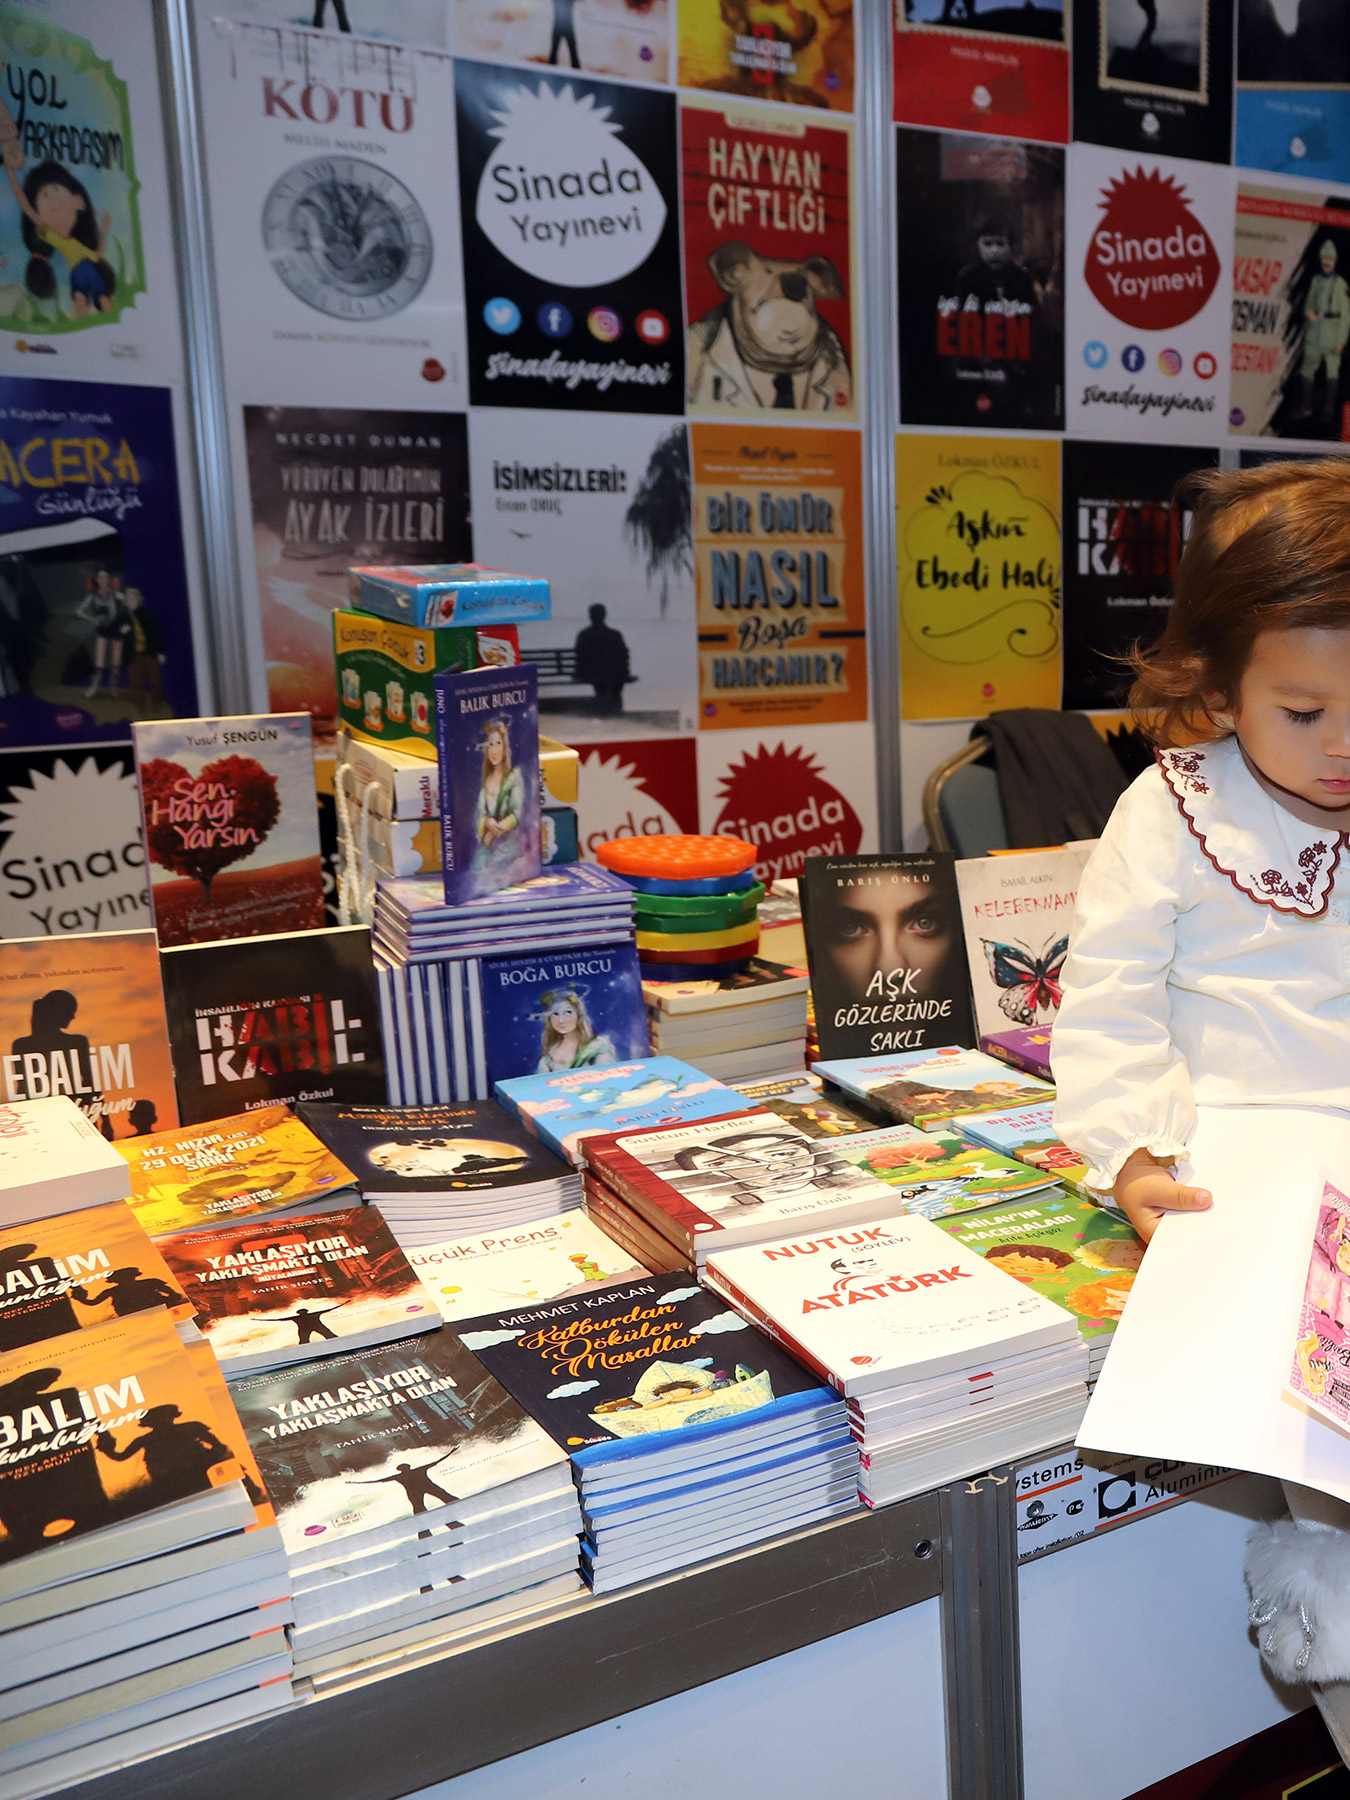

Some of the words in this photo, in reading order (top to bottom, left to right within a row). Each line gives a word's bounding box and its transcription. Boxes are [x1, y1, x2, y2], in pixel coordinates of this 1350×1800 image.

[6, 63, 67, 138] YOL
[261, 76, 416, 133] KÖTÜ
[709, 137, 821, 189] HAYVAN
[493, 158, 642, 205] Sinada
[509, 206, 643, 246] Yayınevi
[1096, 226, 1207, 268] Sinada
[1105, 266, 1203, 300] Yayınevi
[937, 310, 1032, 361] EREN
[275, 432, 356, 446] NECDET
[369, 434, 441, 448] DUMAN
[284, 498, 351, 543] AYAK
[757, 490, 834, 533] ÖMÜR
[711, 548, 840, 611] NASIL
[914, 557, 991, 593] Ebedi
[459, 693, 490, 715] BALIK
[492, 688, 528, 708] BURCU
[186, 734, 219, 746] Yusuf
[222, 730, 279, 747] ŞENGÜN
[152, 796, 236, 827] Hangi
[717, 796, 846, 850] Sinada
[173, 823, 260, 850] Yarsın
[3, 829, 147, 902] Sinad
[836, 878, 882, 888] BARIŞ
[891, 874, 931, 886] ÜNLÜ
[974, 892, 1079, 920] KELEBEKNAM
[500, 966, 550, 987] BOĞA
[554, 958, 613, 979] BURCU
[866, 968, 921, 1002] AŞK
[834, 998, 952, 1028] GÖZLERİNDE
[870, 1029, 925, 1052] SAKLI
[299, 1086, 335, 1105] Özkul
[694, 1117, 758, 1136] Harfler
[220, 1135, 267, 1154] 2021
[478, 1225, 559, 1253] Prens
[762, 1226, 896, 1261] NUTUK
[850, 1236, 912, 1255] (SÖYLEV)
[958, 1214, 1077, 1244] MACERALARI
[194, 1256, 327, 1284] YAKLAŞMAKTA
[326, 1245, 370, 1264] OLAN
[205, 1235, 350, 1270] YAKLAŞIYOR
[498, 1302, 581, 1328] MEHMET
[582, 1284, 657, 1310] KAPLAN
[801, 1264, 974, 1315] ATATÜRK
[551, 1334, 703, 1377] Masallar
[260, 1393, 410, 1441] YAKLAŞMAKTA
[404, 1375, 458, 1400] OLAN
[267, 1364, 433, 1422] YAKLAŞIYOR
